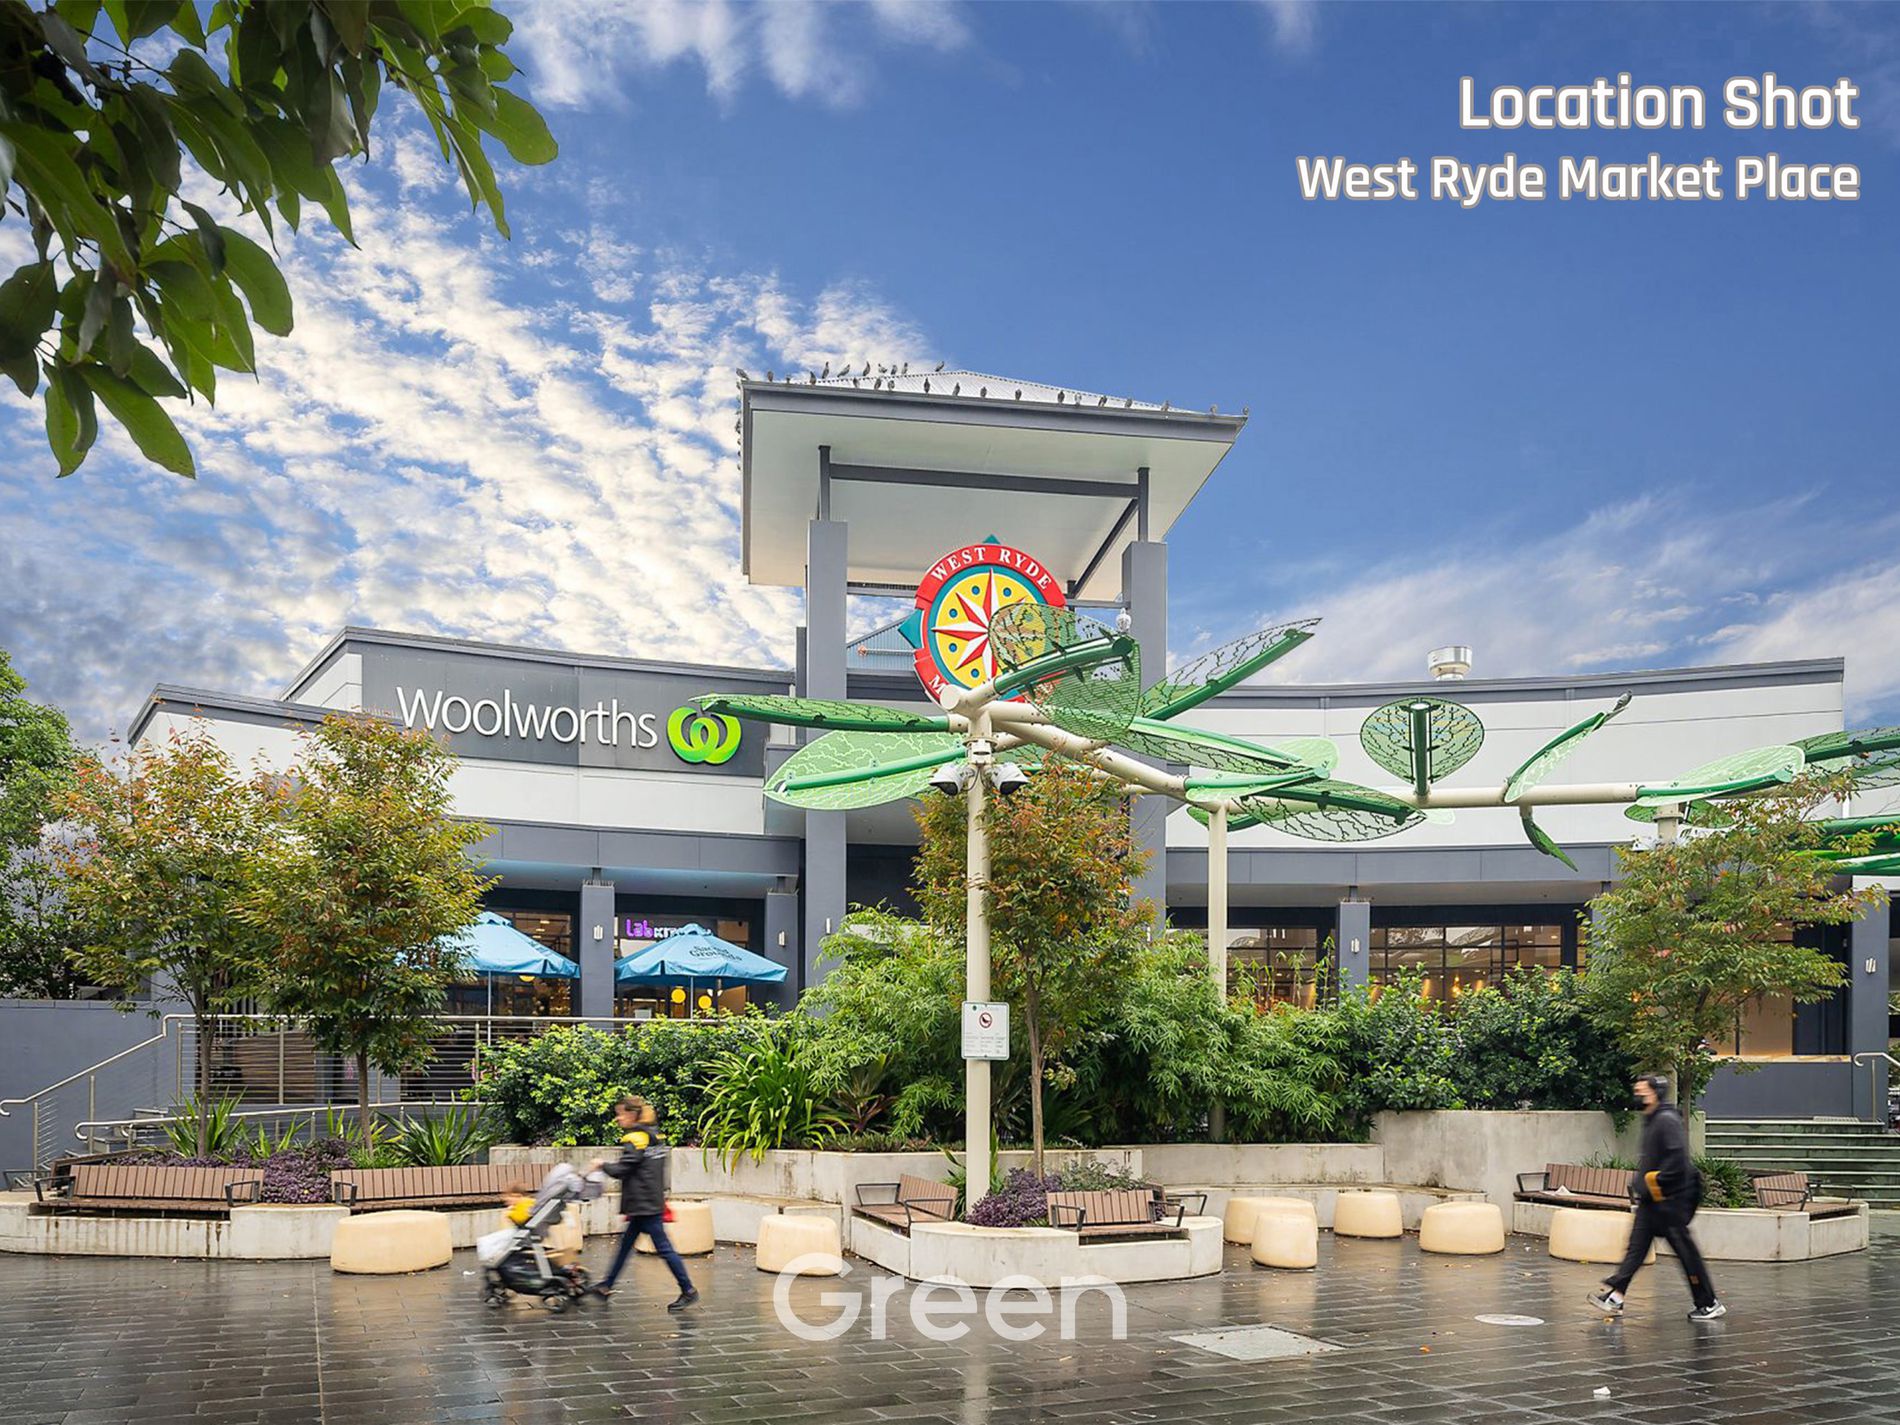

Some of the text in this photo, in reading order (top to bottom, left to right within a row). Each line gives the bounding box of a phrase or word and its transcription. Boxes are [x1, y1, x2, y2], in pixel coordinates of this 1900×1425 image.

[931, 547, 1052, 590] WEST RYDE
[396, 686, 658, 749] Woolworths
